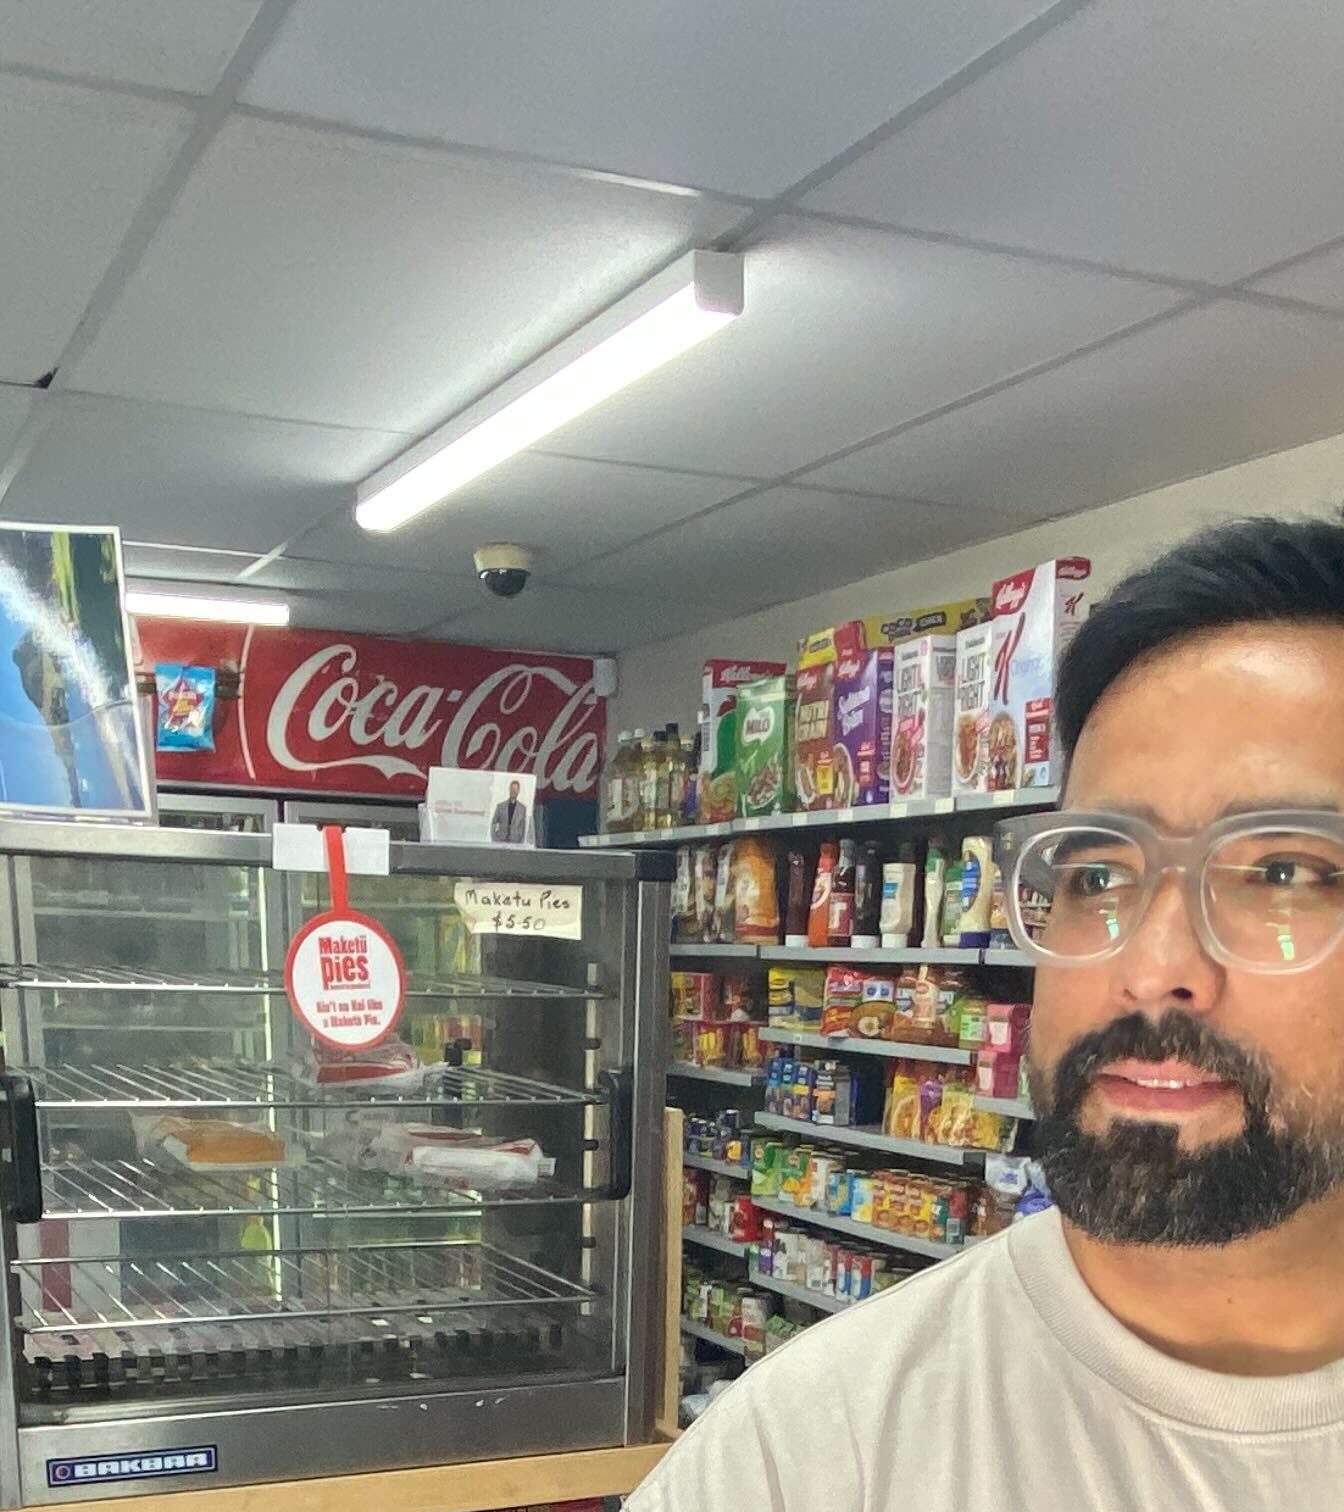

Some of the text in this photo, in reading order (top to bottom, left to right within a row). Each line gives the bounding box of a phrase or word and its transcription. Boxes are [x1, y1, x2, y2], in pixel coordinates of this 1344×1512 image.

[267, 645, 606, 792] Coca-Cola
[539, 889, 571, 910] Pies
[319, 955, 369, 991] pies
